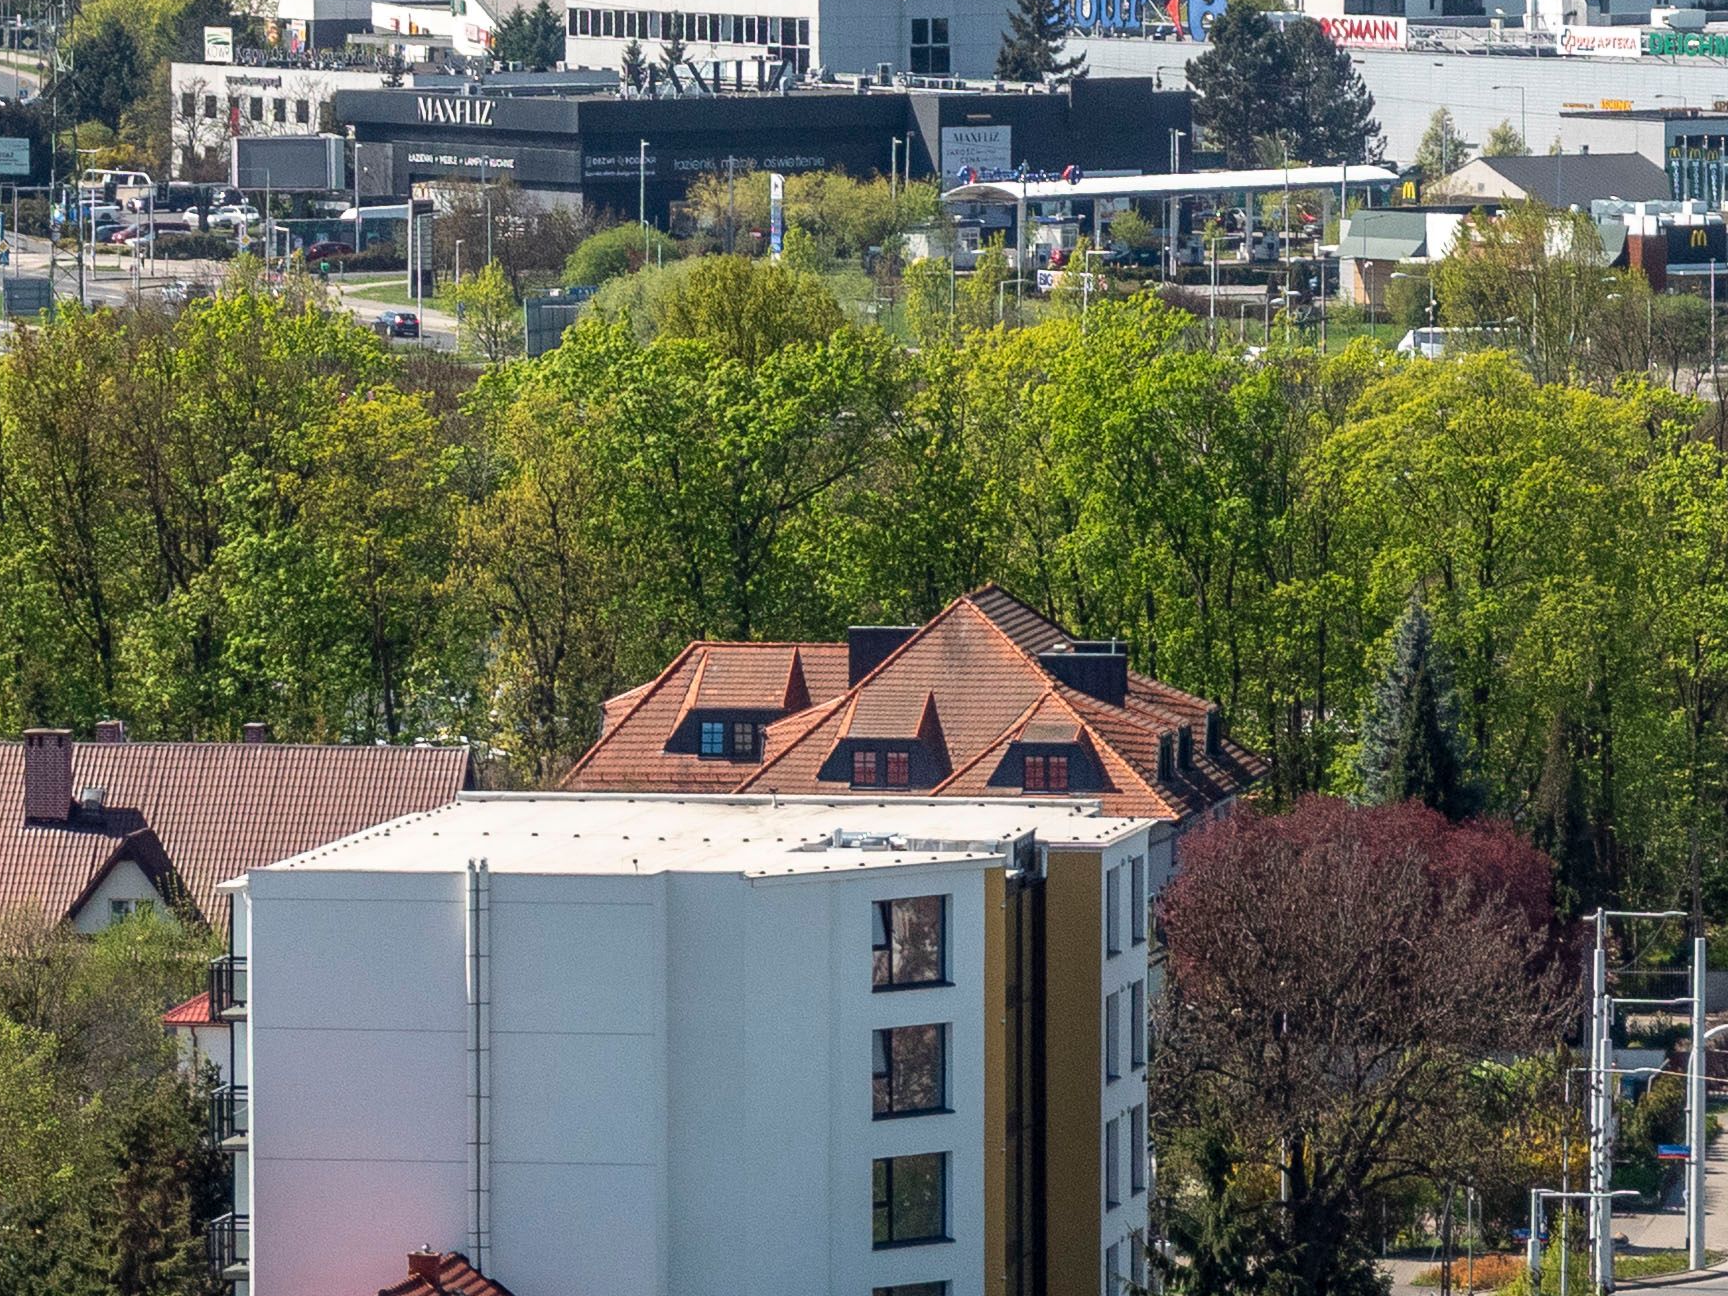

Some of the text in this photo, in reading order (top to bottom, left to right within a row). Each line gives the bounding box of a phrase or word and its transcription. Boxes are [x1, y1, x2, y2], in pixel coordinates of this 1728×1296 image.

[1319, 17, 1399, 42] OSSMANN
[1597, 36, 1637, 50] APTEKA
[417, 96, 493, 125] MAXFLIZ
